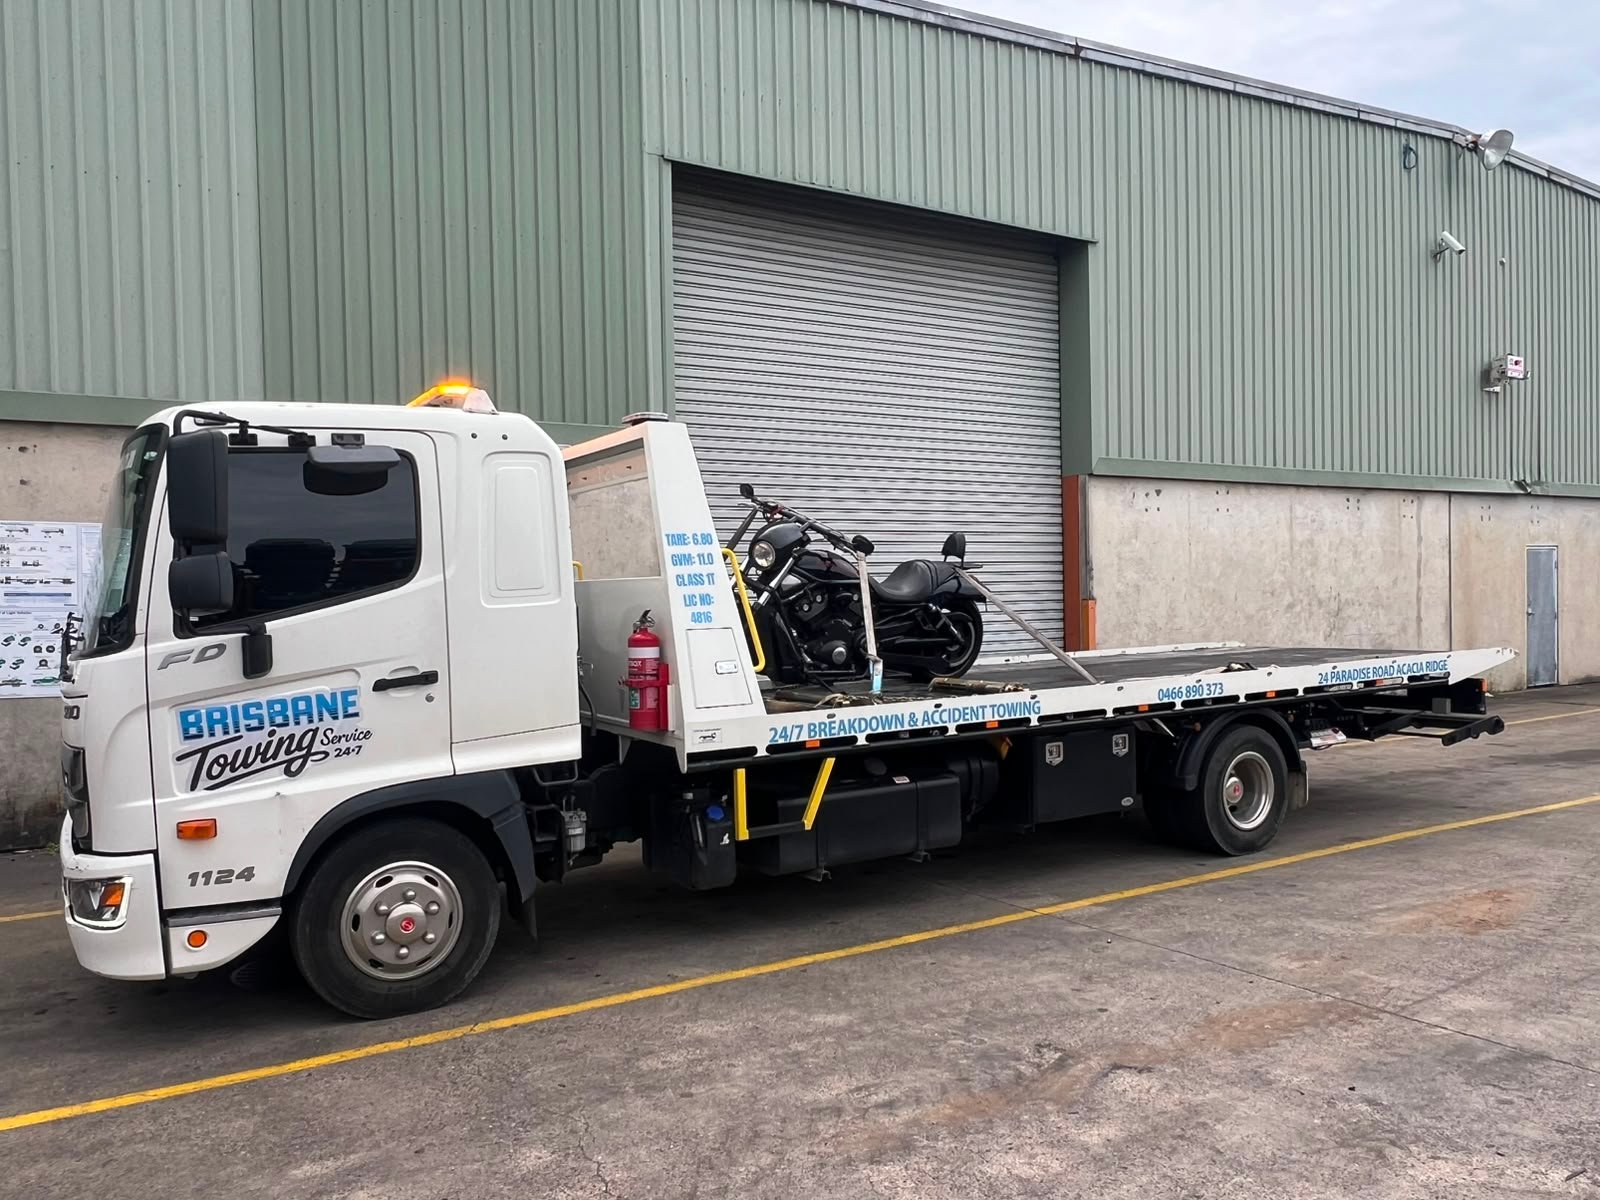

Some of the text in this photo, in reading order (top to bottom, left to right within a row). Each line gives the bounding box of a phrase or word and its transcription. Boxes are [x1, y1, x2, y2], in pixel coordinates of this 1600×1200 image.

[664, 532, 713, 547] TARE: 6.80
[671, 552, 715, 567] GVM: 11.0
[675, 572, 705, 587] CLASS
[683, 592, 715, 608] LIC NO:
[690, 610, 713, 624] 4816
[156, 642, 227, 671] FD
[1318, 659, 1448, 684] 24 PARADISE ROAD ACACIA RIDGE
[1158, 682, 1224, 701] 0466 890 373
[178, 688, 361, 742] BRISBANE
[768, 700, 1041, 744] 24/7 BREAKDOWN & ACCIDENT TOWING
[175, 726, 373, 792] Towing Service
[187, 866, 256, 887] 1124
